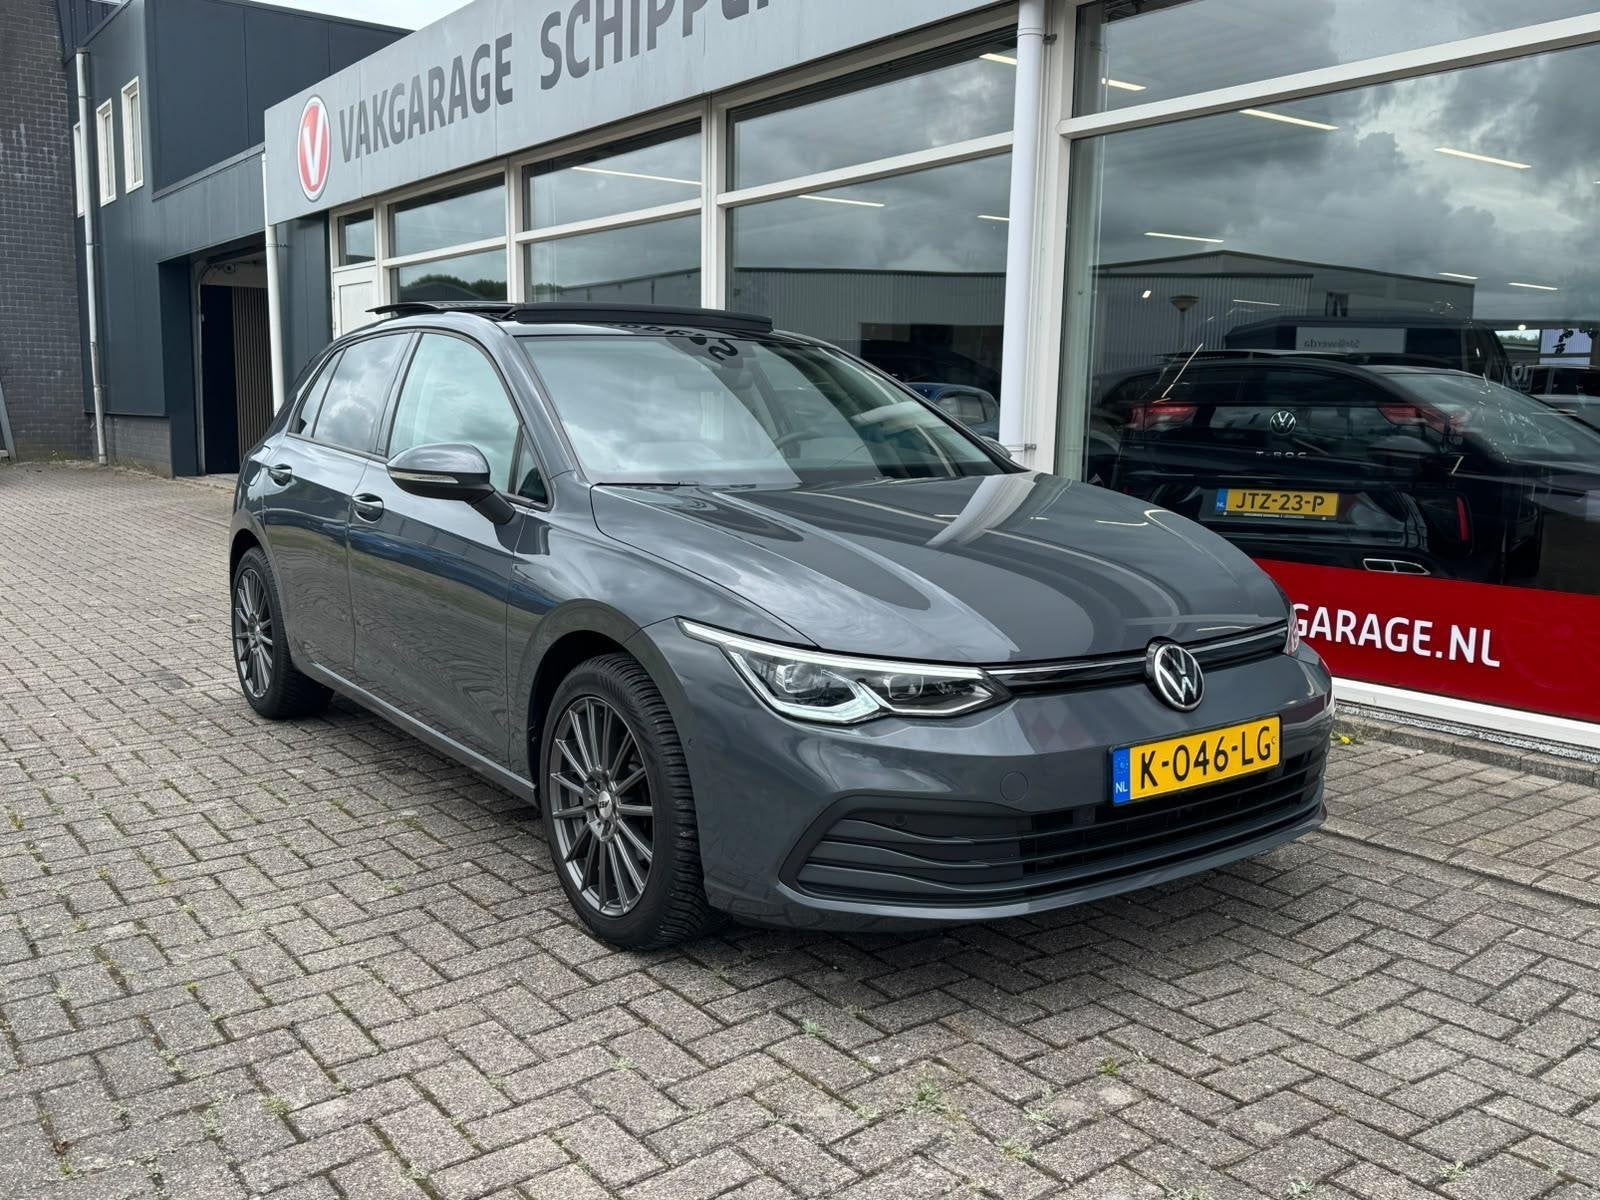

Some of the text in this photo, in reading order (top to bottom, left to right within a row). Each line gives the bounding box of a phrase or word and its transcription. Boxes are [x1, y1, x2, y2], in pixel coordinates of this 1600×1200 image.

[339, 33, 513, 163] VAKGARAGE
[1236, 492, 1325, 512] JTZ-23-P
[1115, 725, 1272, 793] NL K-046-LG
